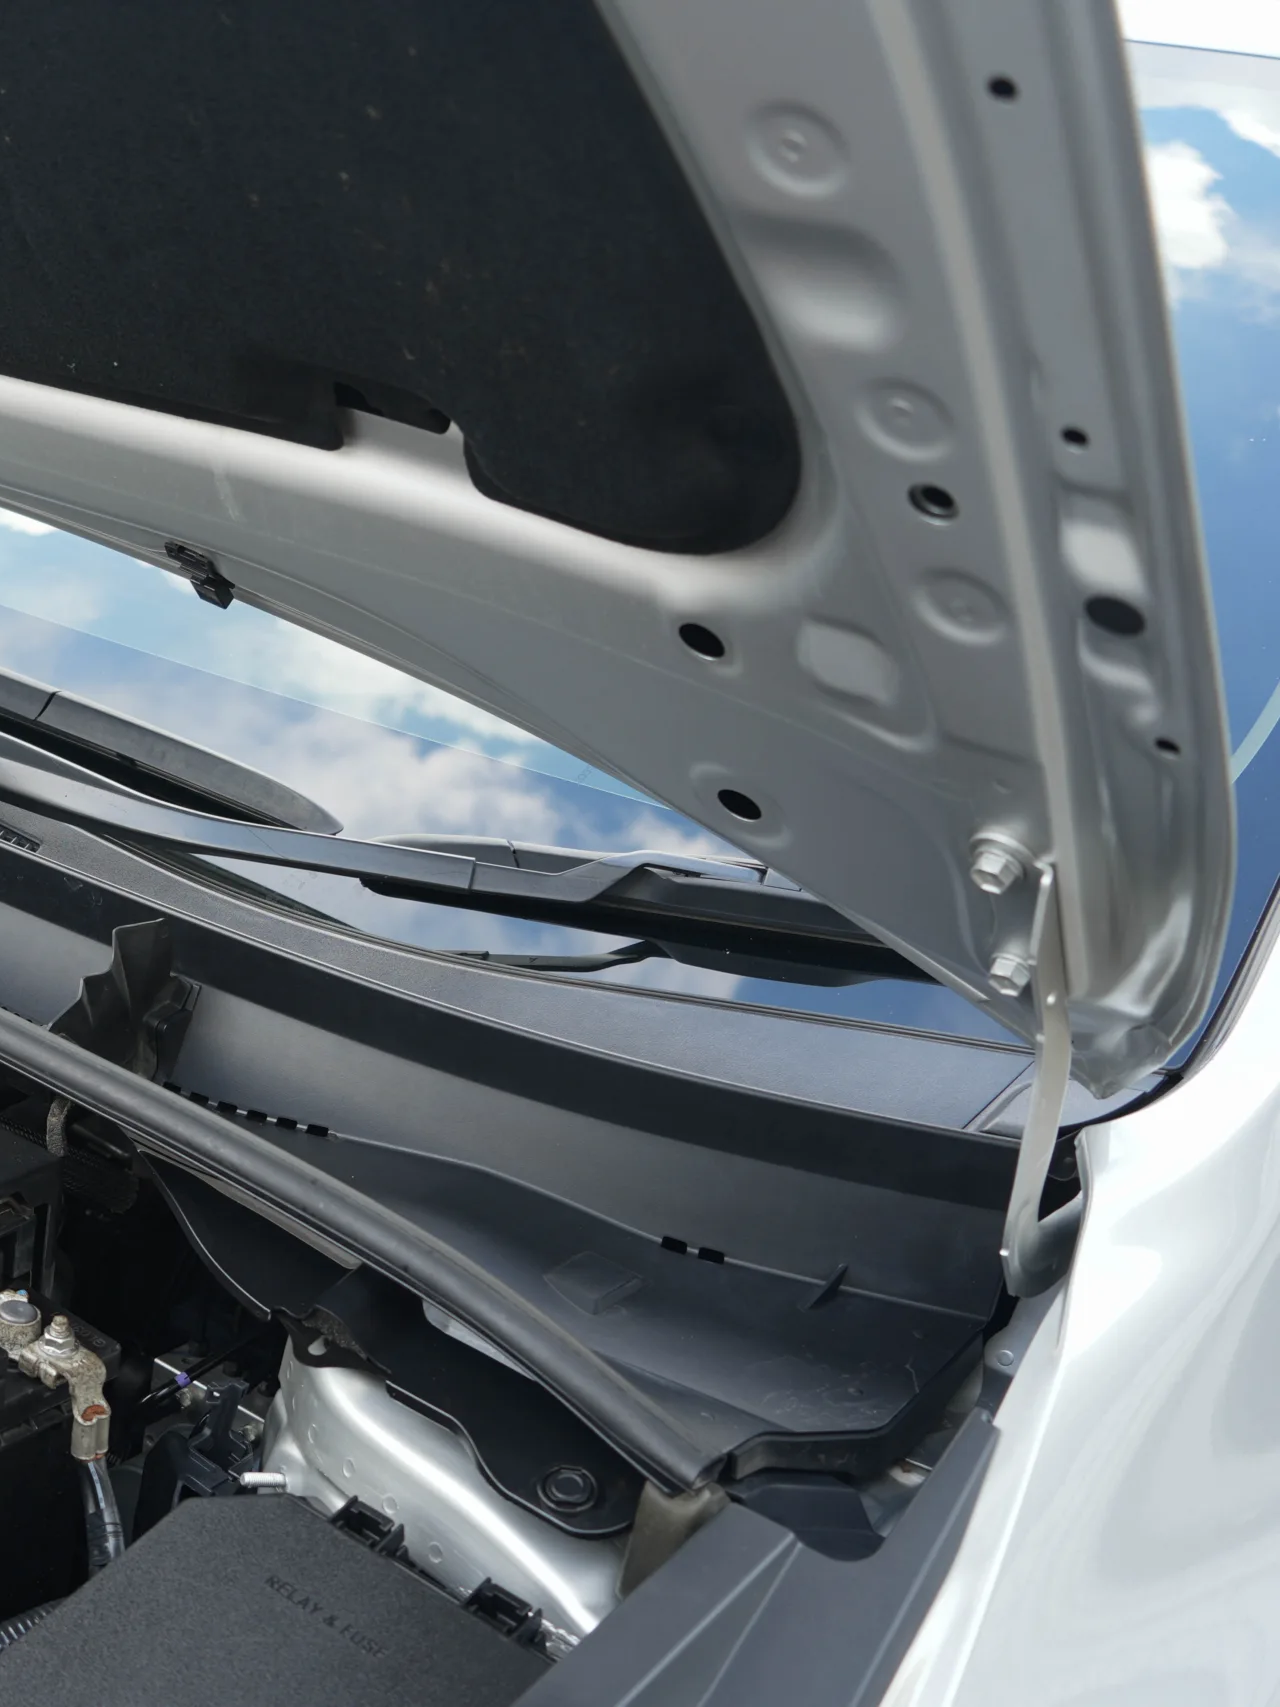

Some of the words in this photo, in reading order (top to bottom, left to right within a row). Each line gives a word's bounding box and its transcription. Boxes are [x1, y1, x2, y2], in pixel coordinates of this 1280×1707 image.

[264, 1575, 323, 1615] RELAY
[322, 1615, 339, 1628] &
[339, 1624, 388, 1658] FUSE
